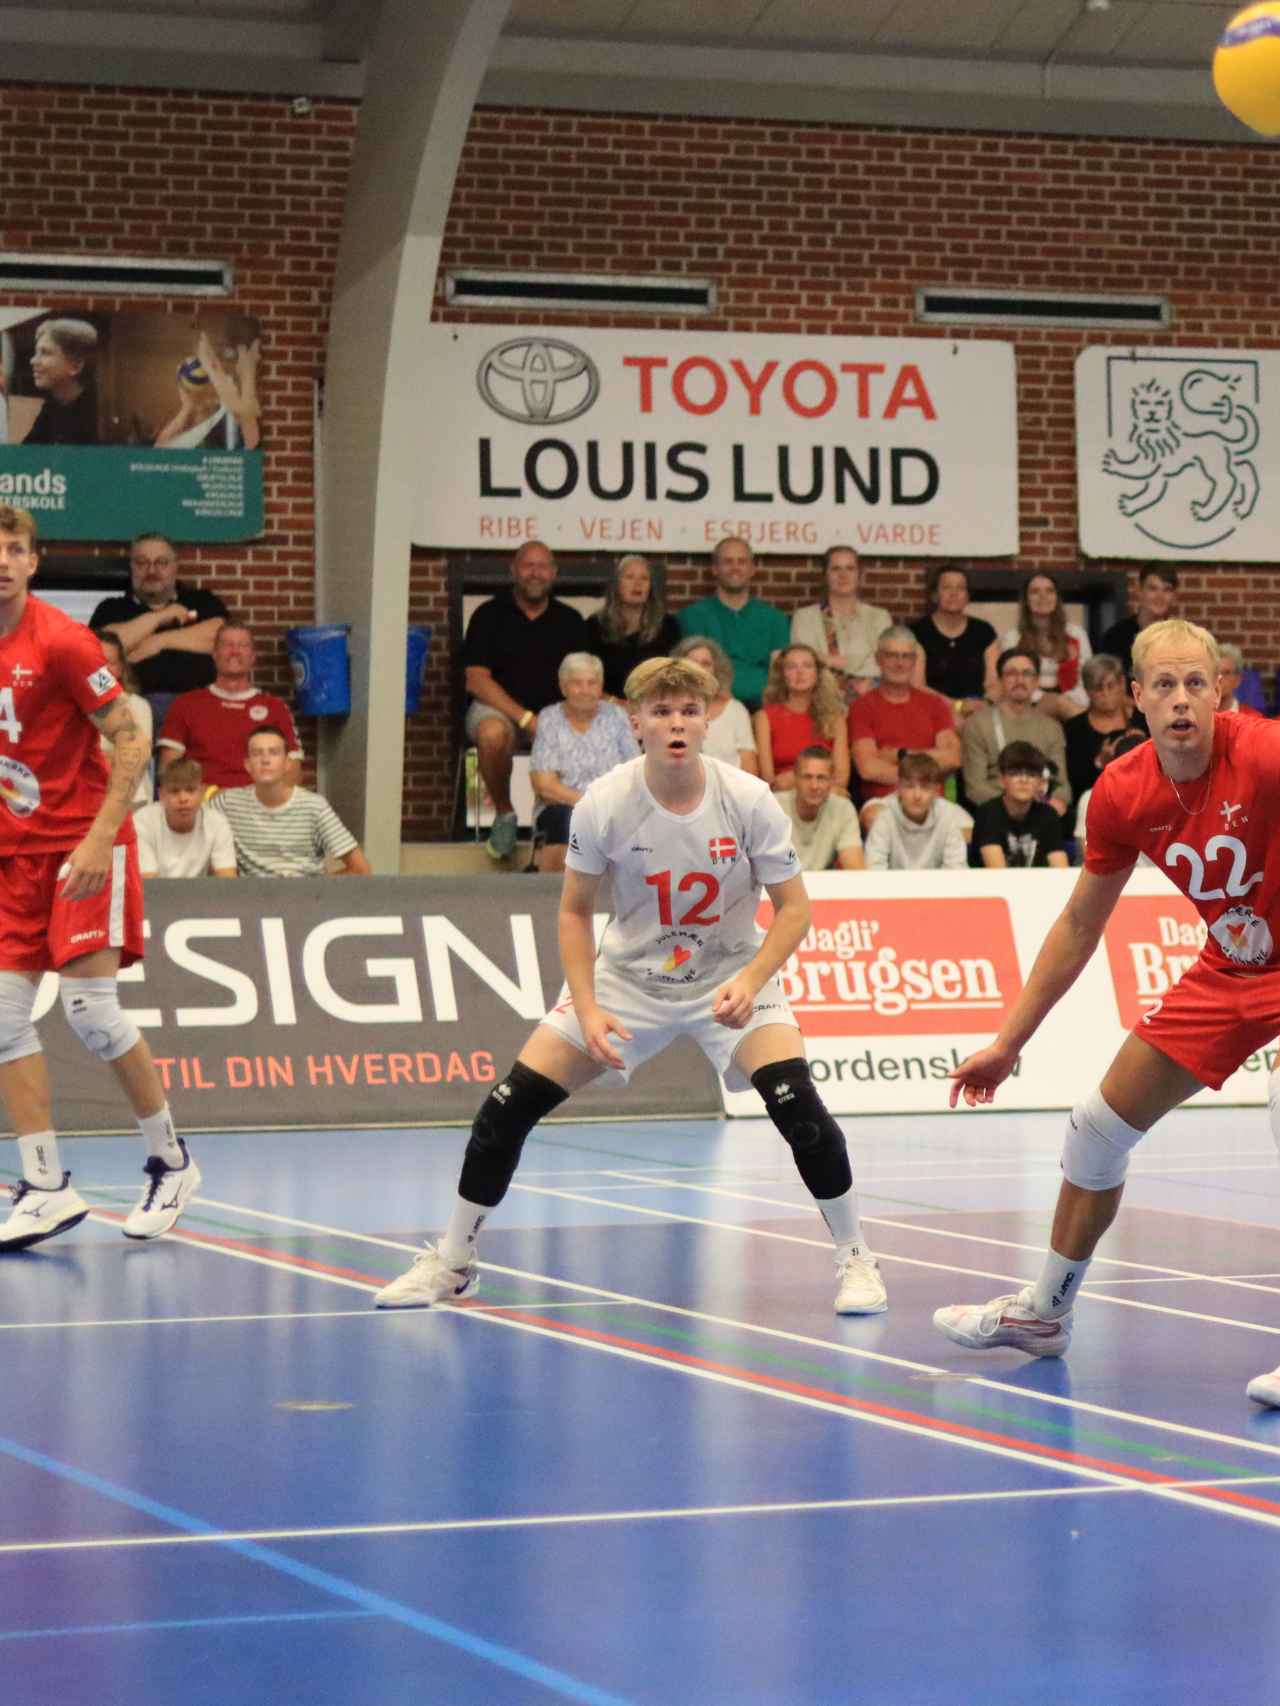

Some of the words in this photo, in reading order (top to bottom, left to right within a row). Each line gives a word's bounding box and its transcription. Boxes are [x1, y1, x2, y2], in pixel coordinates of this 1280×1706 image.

[622, 355, 938, 421] TOYOTA
[478, 437, 709, 502] LOUIS
[732, 443, 940, 506] LUND
[479, 516, 538, 540] RIBE
[580, 518, 664, 541] VEJEN
[704, 520, 819, 545] ESBJERG
[857, 523, 942, 546] VARDE
[1165, 834, 1265, 901] 22
[645, 870, 721, 927] 12
[225, 1055, 295, 1088] DIN
[306, 1050, 497, 1087] HVERDAG
